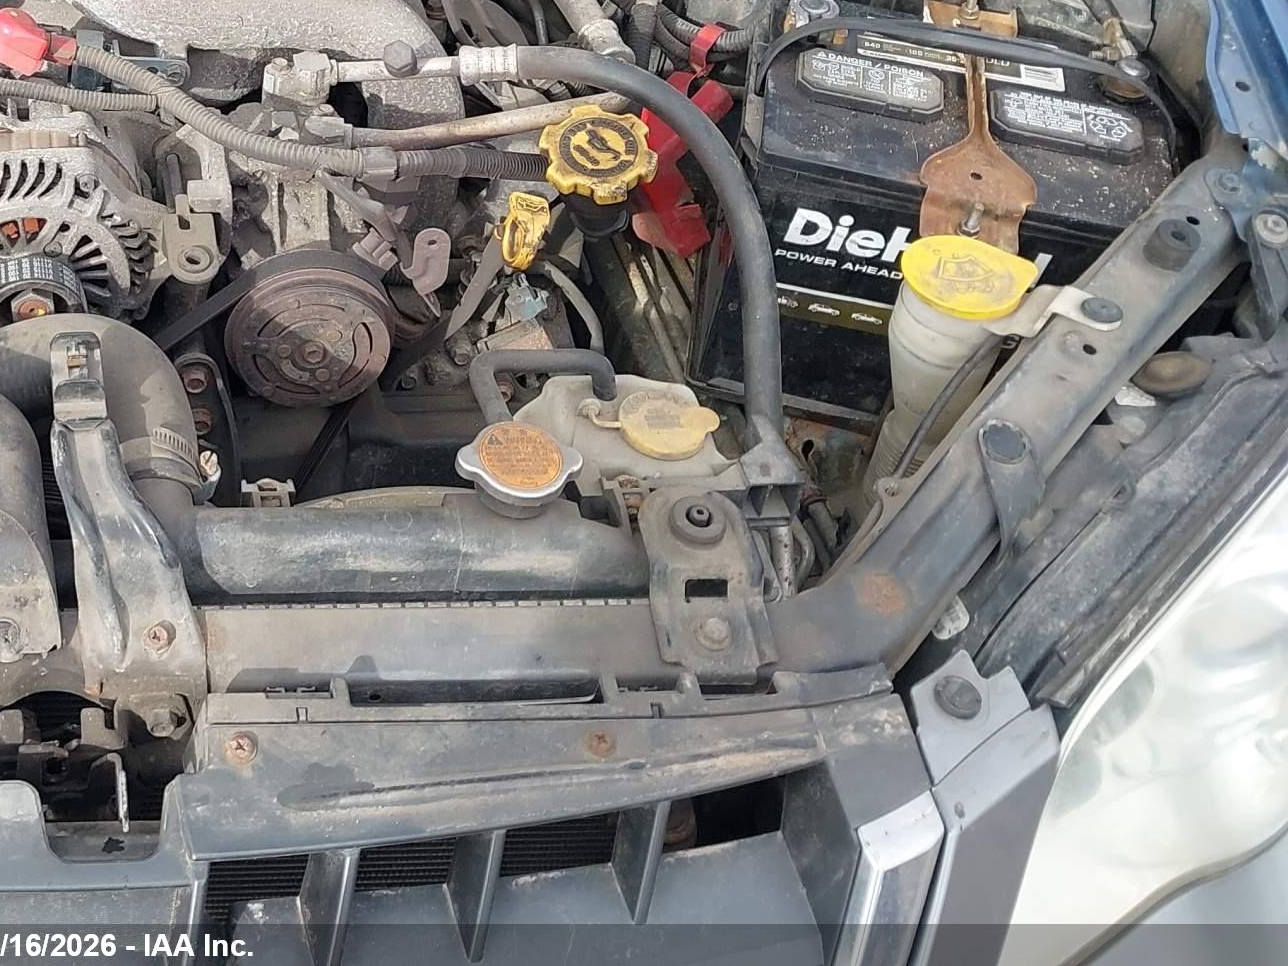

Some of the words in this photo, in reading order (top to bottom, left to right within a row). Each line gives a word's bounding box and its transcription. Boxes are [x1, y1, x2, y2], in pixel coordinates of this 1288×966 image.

[828, 53, 873, 67] DANGER
[884, 64, 924, 77] POISON
[775, 248, 837, 268] POWER
[842, 261, 903, 280] AHEAD
